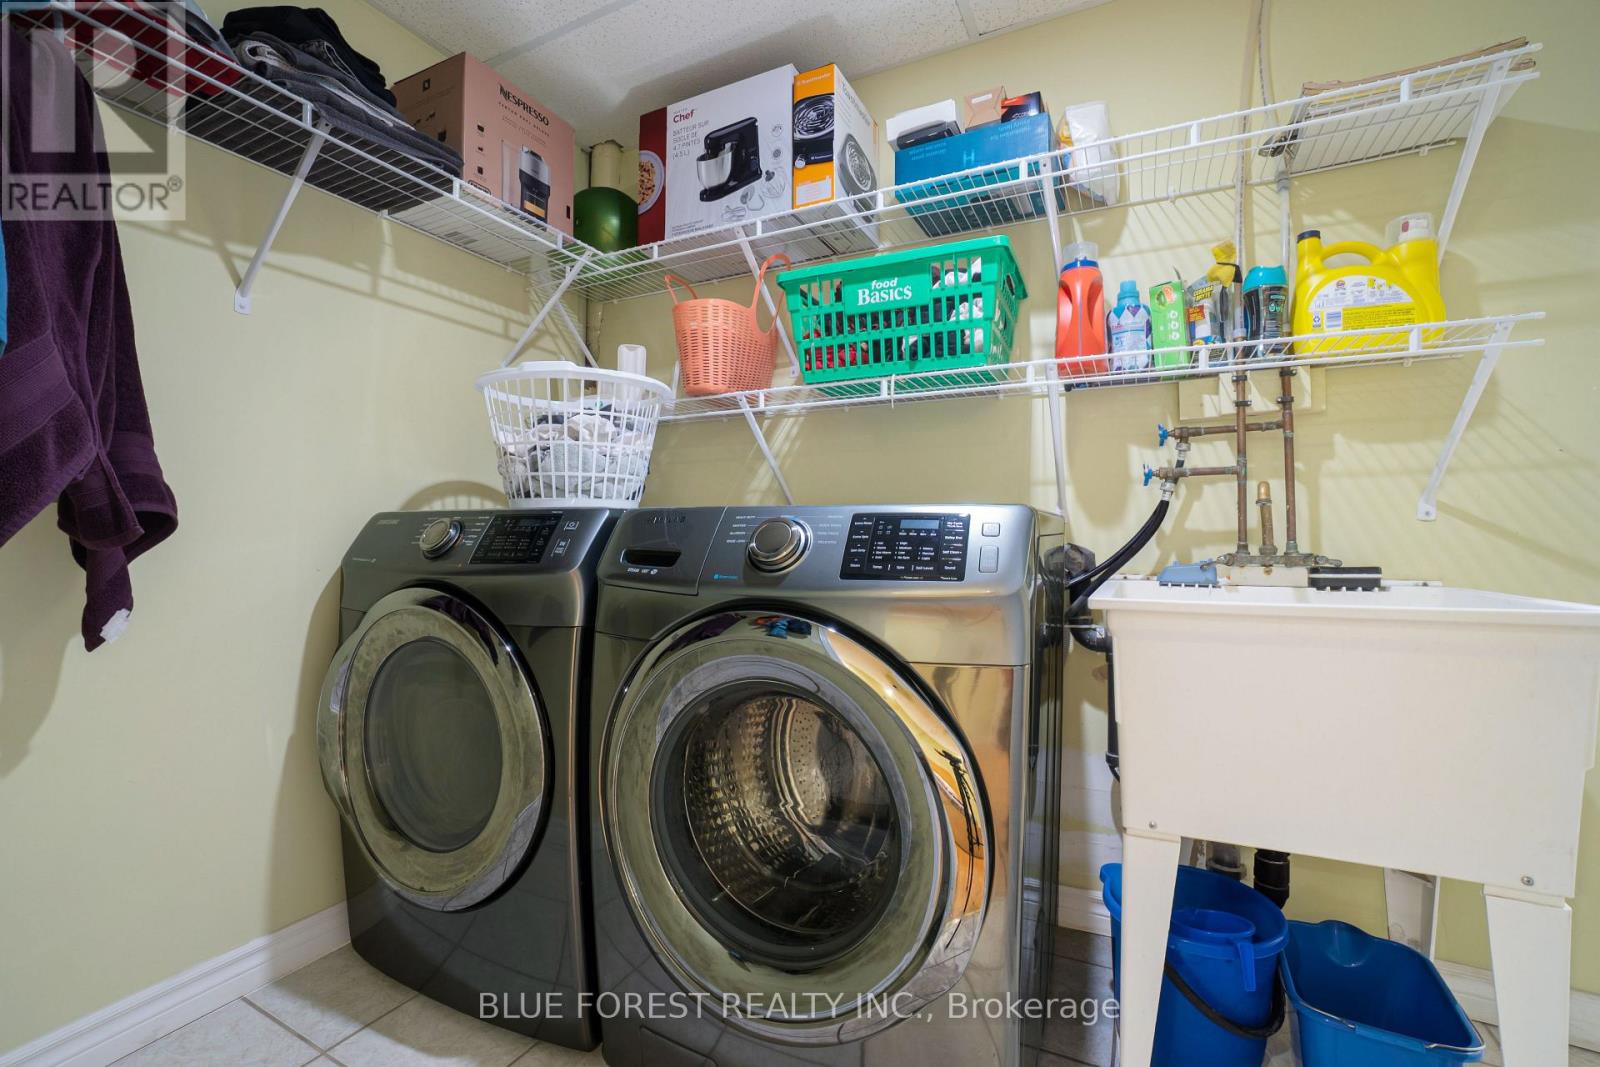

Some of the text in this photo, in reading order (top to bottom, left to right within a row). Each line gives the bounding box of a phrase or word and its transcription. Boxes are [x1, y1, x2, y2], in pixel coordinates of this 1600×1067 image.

[499, 84, 549, 126] NESPRESSO
[673, 109, 695, 123] Chef
[871, 277, 898, 290] food
